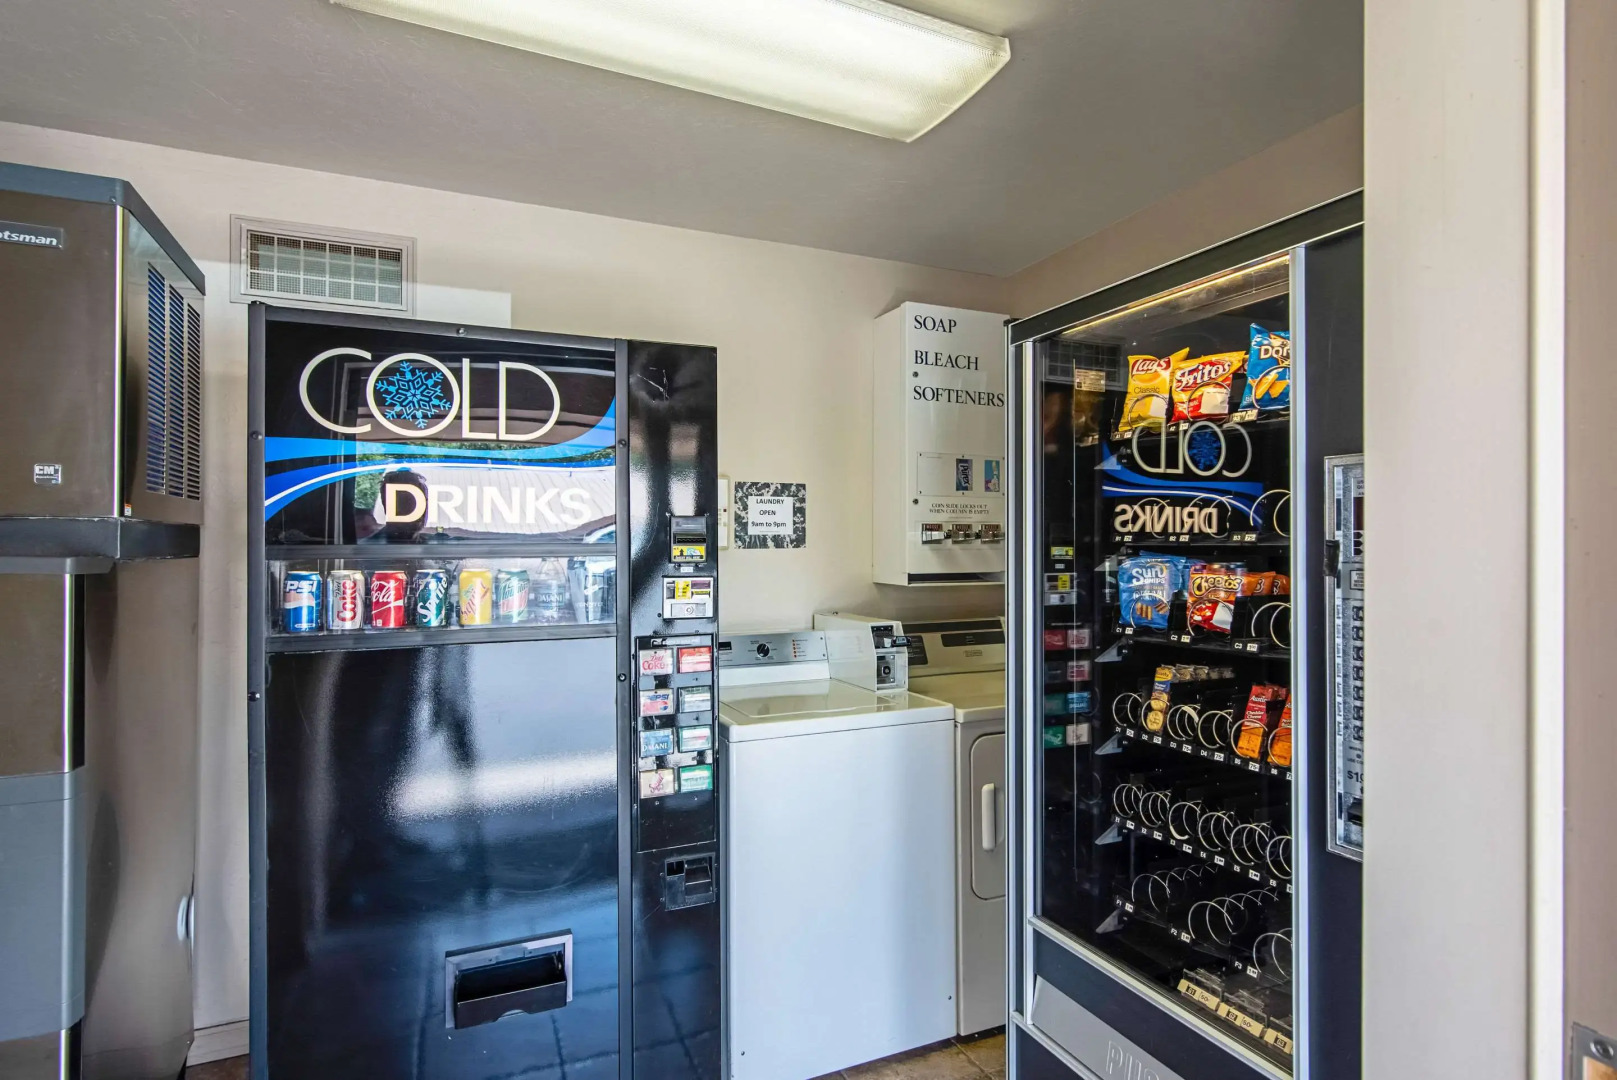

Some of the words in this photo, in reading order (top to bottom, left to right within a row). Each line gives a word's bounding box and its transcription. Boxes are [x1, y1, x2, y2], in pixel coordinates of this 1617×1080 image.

[914, 314, 957, 333] SOAP
[914, 350, 979, 371] BLEACH
[1175, 360, 1232, 392] Fritos
[299, 347, 561, 441] COLD
[913, 385, 1005, 408] SOFTENERS
[1134, 386, 1160, 394] Classic
[386, 482, 592, 525] DRINKS
[1131, 565, 1167, 586] Sun
[1192, 575, 1244, 596] Cheetos
[337, 580, 357, 622] Coke
[642, 660, 665, 671] Coke
[1200, 749, 1208, 757] D4
[1170, 928, 1178, 936] F2
[1234, 960, 1243, 970] F3
